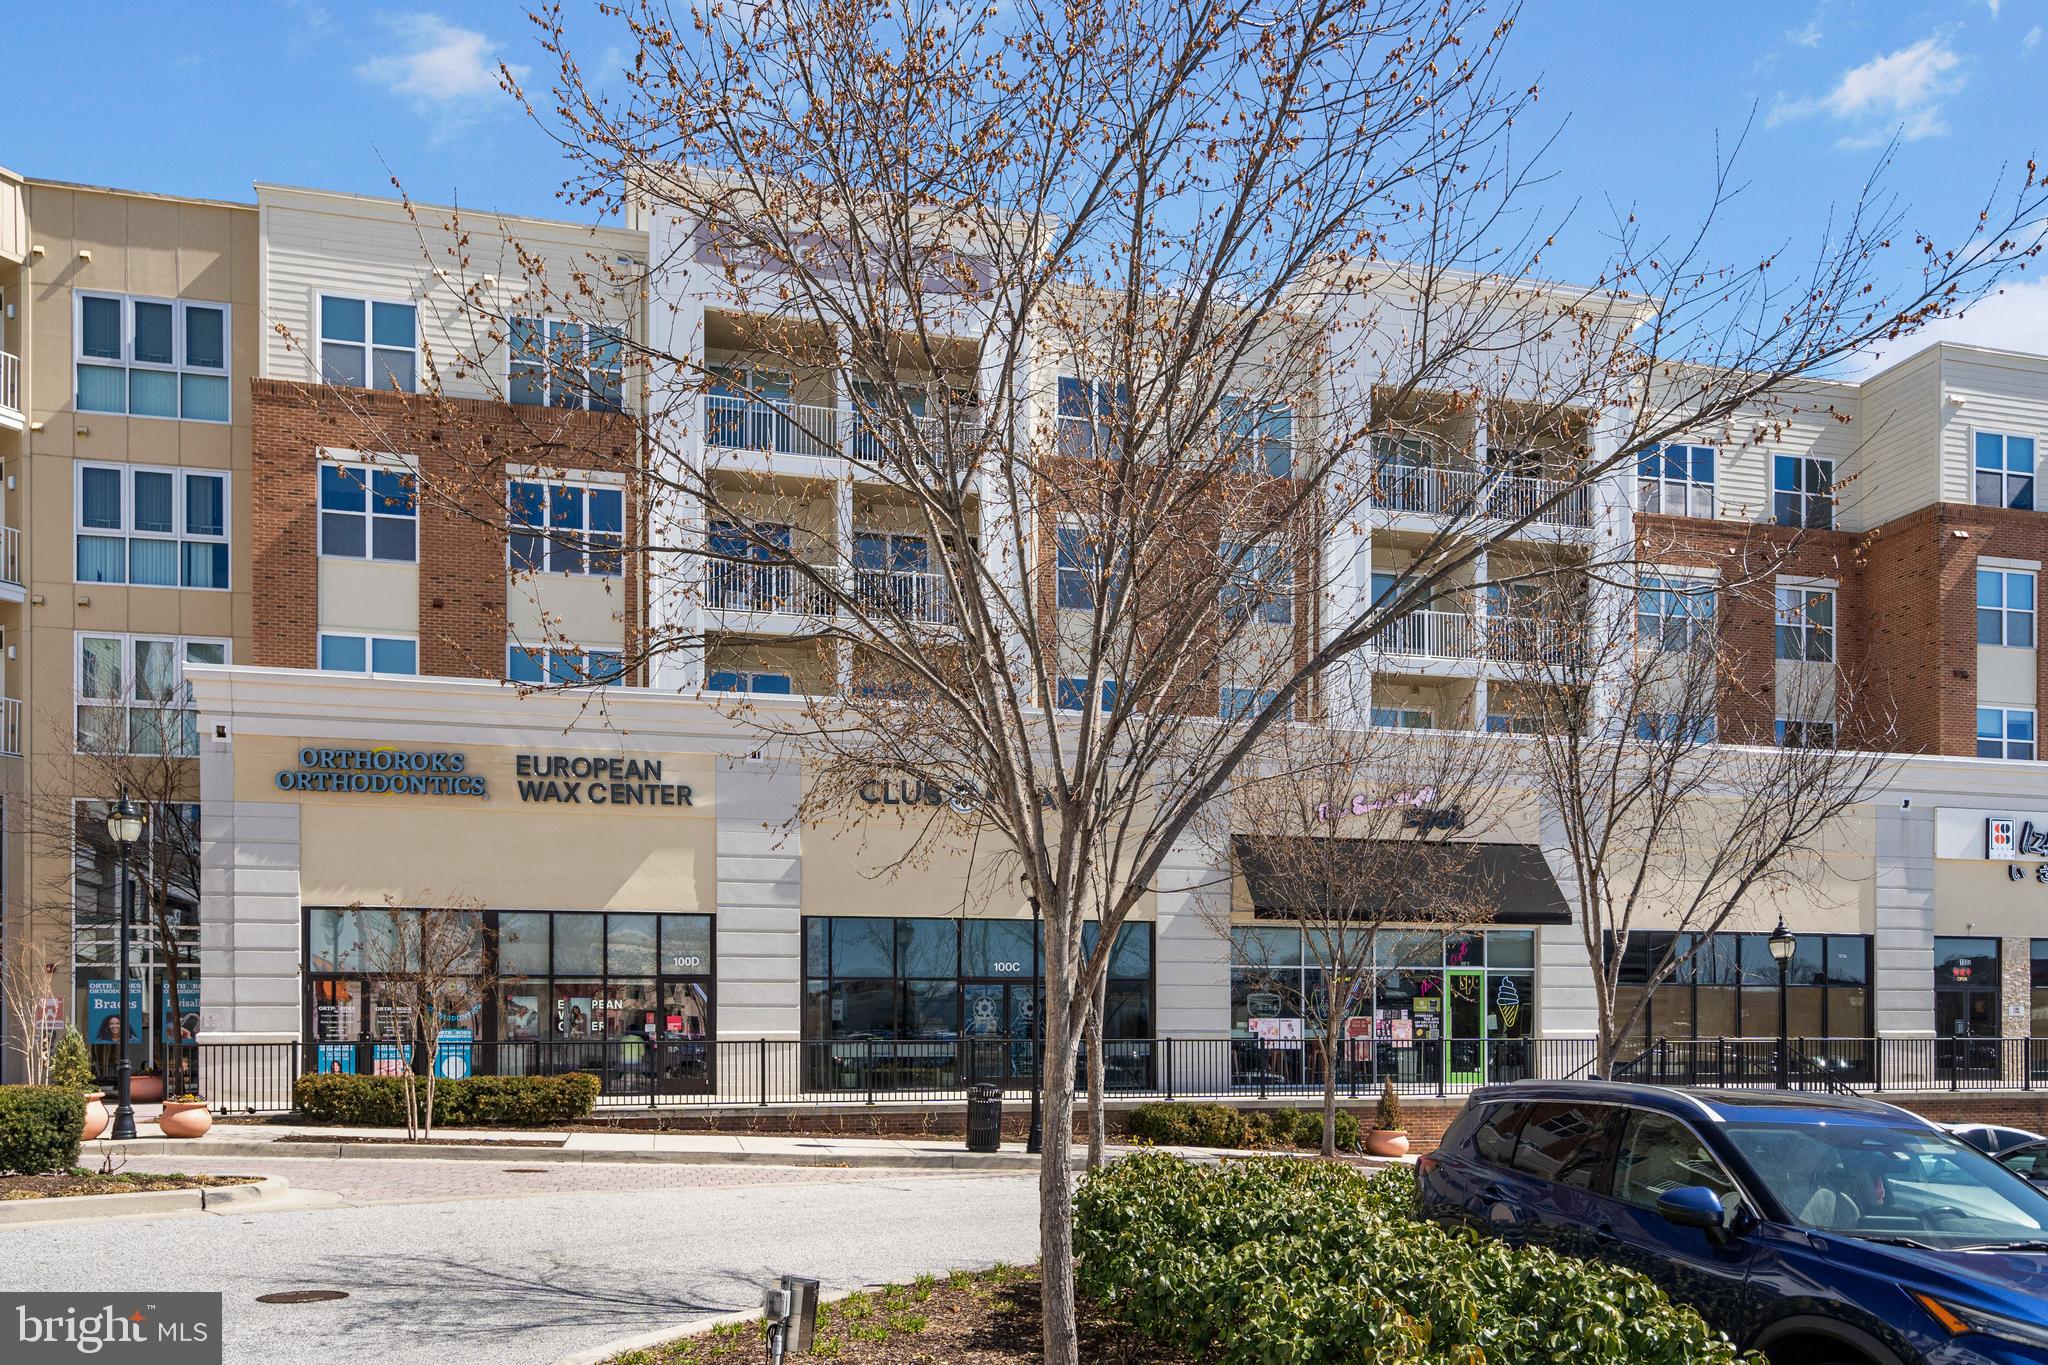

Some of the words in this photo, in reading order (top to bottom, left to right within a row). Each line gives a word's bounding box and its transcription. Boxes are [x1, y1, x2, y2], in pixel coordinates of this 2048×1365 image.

[299, 747, 465, 773] ORTHOROKS
[516, 755, 662, 781] EUROPEAN
[275, 771, 485, 797] ORTHODONTICS
[517, 780, 580, 803] WAX
[587, 782, 694, 807] CENTER
[858, 778, 943, 807] CLUB
[673, 956, 700, 967] 100D
[993, 961, 1021, 972] 100C
[557, 999, 623, 1010] EPEAN
